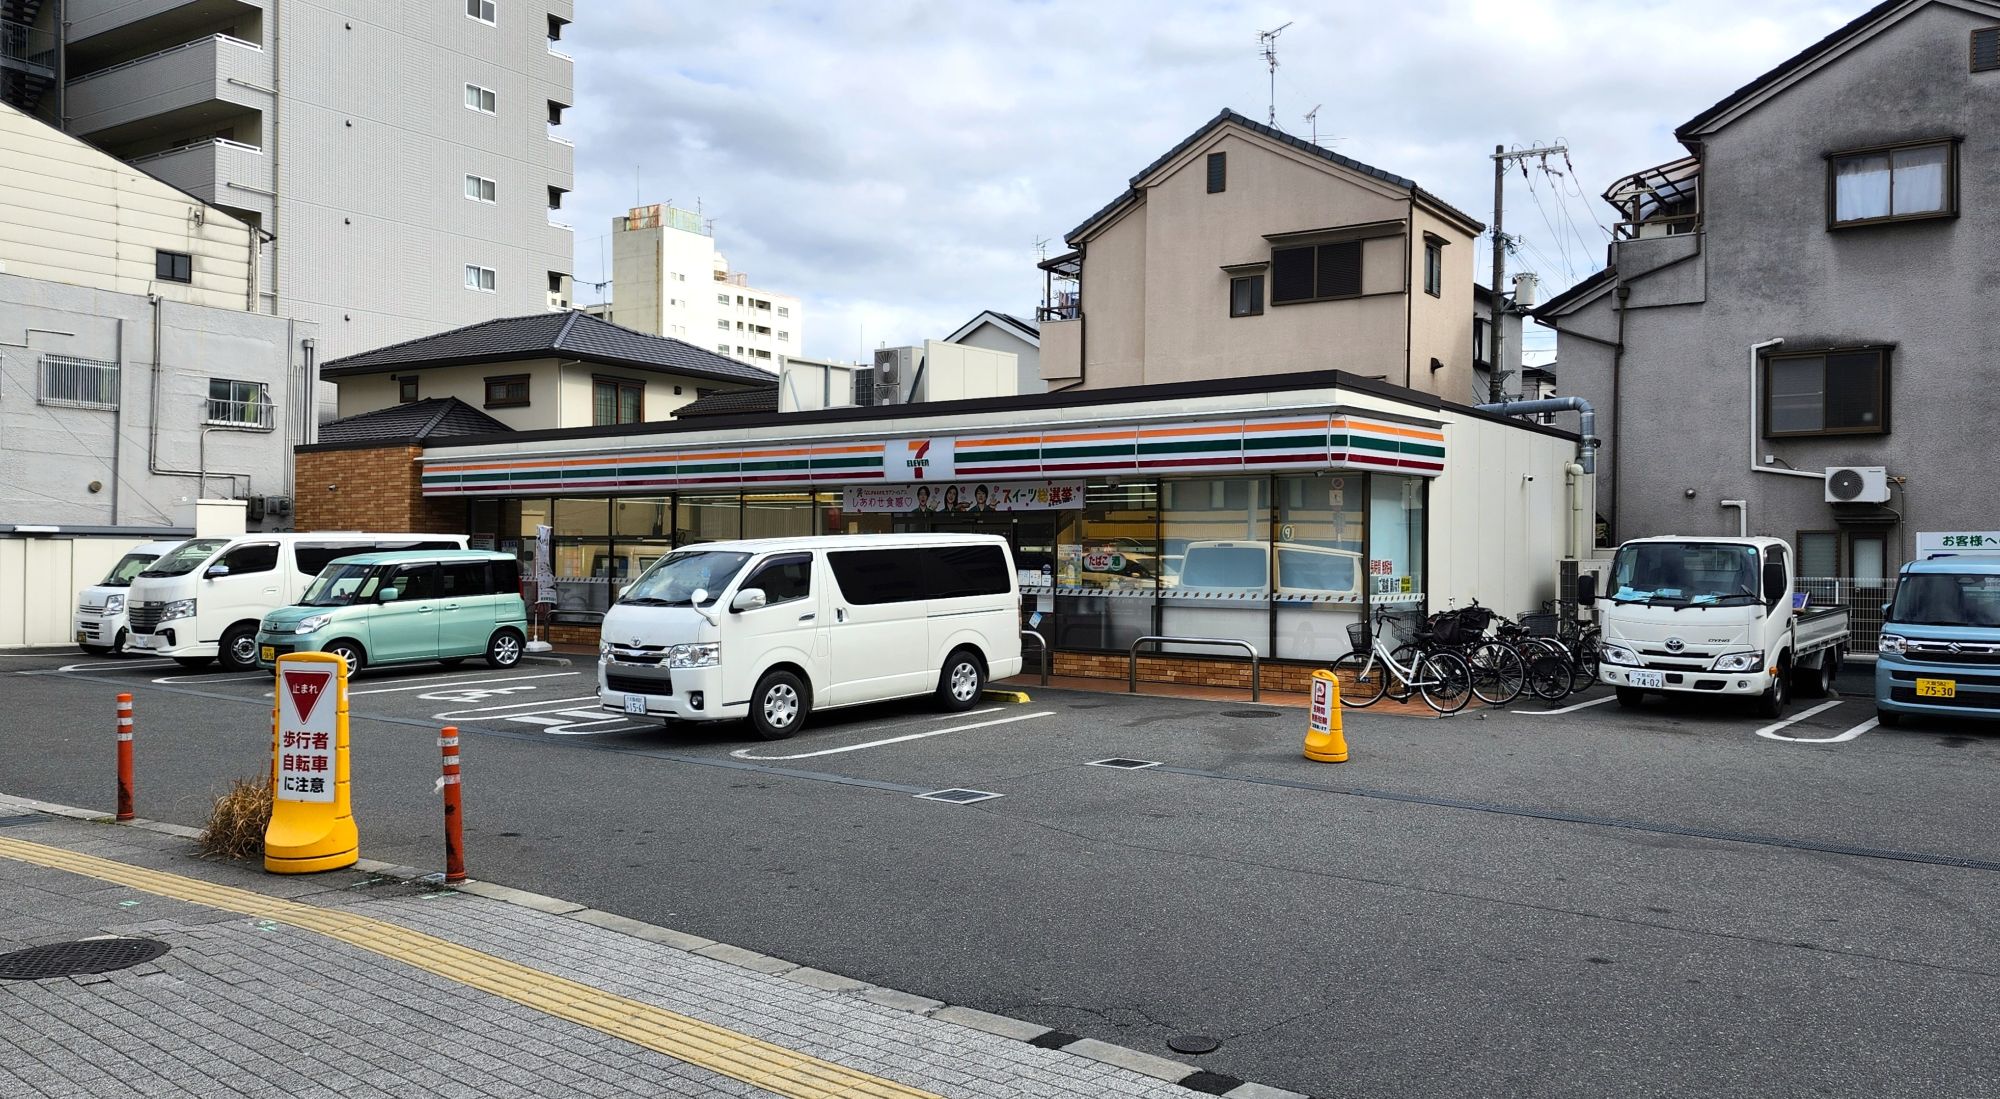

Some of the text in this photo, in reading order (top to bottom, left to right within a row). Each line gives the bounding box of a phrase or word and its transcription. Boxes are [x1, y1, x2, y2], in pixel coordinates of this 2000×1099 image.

[908, 439, 930, 479] 7
[1942, 535, 2000, 547] お客様へ
[1088, 555, 1109, 567] たばこ
[1636, 677, 1660, 687] 74-02
[292, 684, 318, 694] 止まれ
[1925, 686, 1953, 696] 75-30
[283, 731, 329, 750] 歩行者
[283, 754, 329, 773] 自転車
[284, 776, 325, 793] に注意
